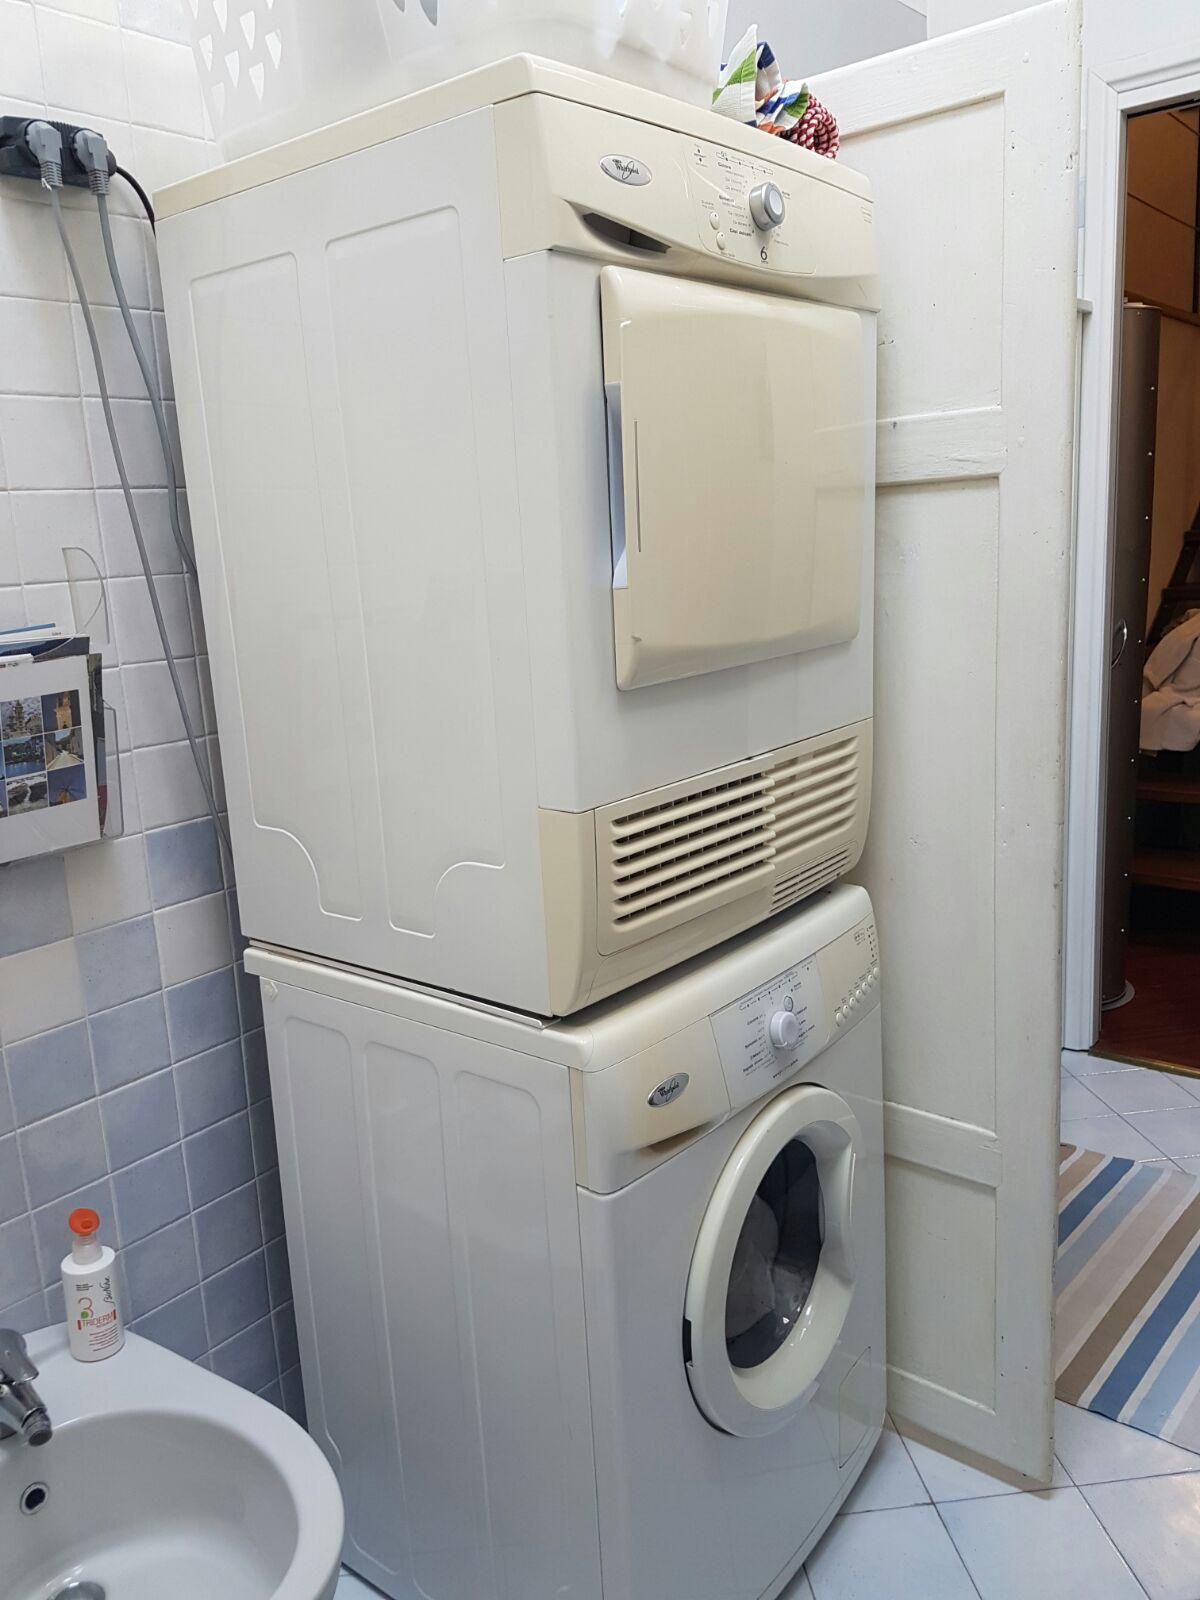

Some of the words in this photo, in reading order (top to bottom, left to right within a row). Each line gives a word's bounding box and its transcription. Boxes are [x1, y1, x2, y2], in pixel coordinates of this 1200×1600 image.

[613, 160, 640, 180] Whirlpool
[760, 246, 768, 261] 6
[82, 1312, 113, 1327] TRIDERM
